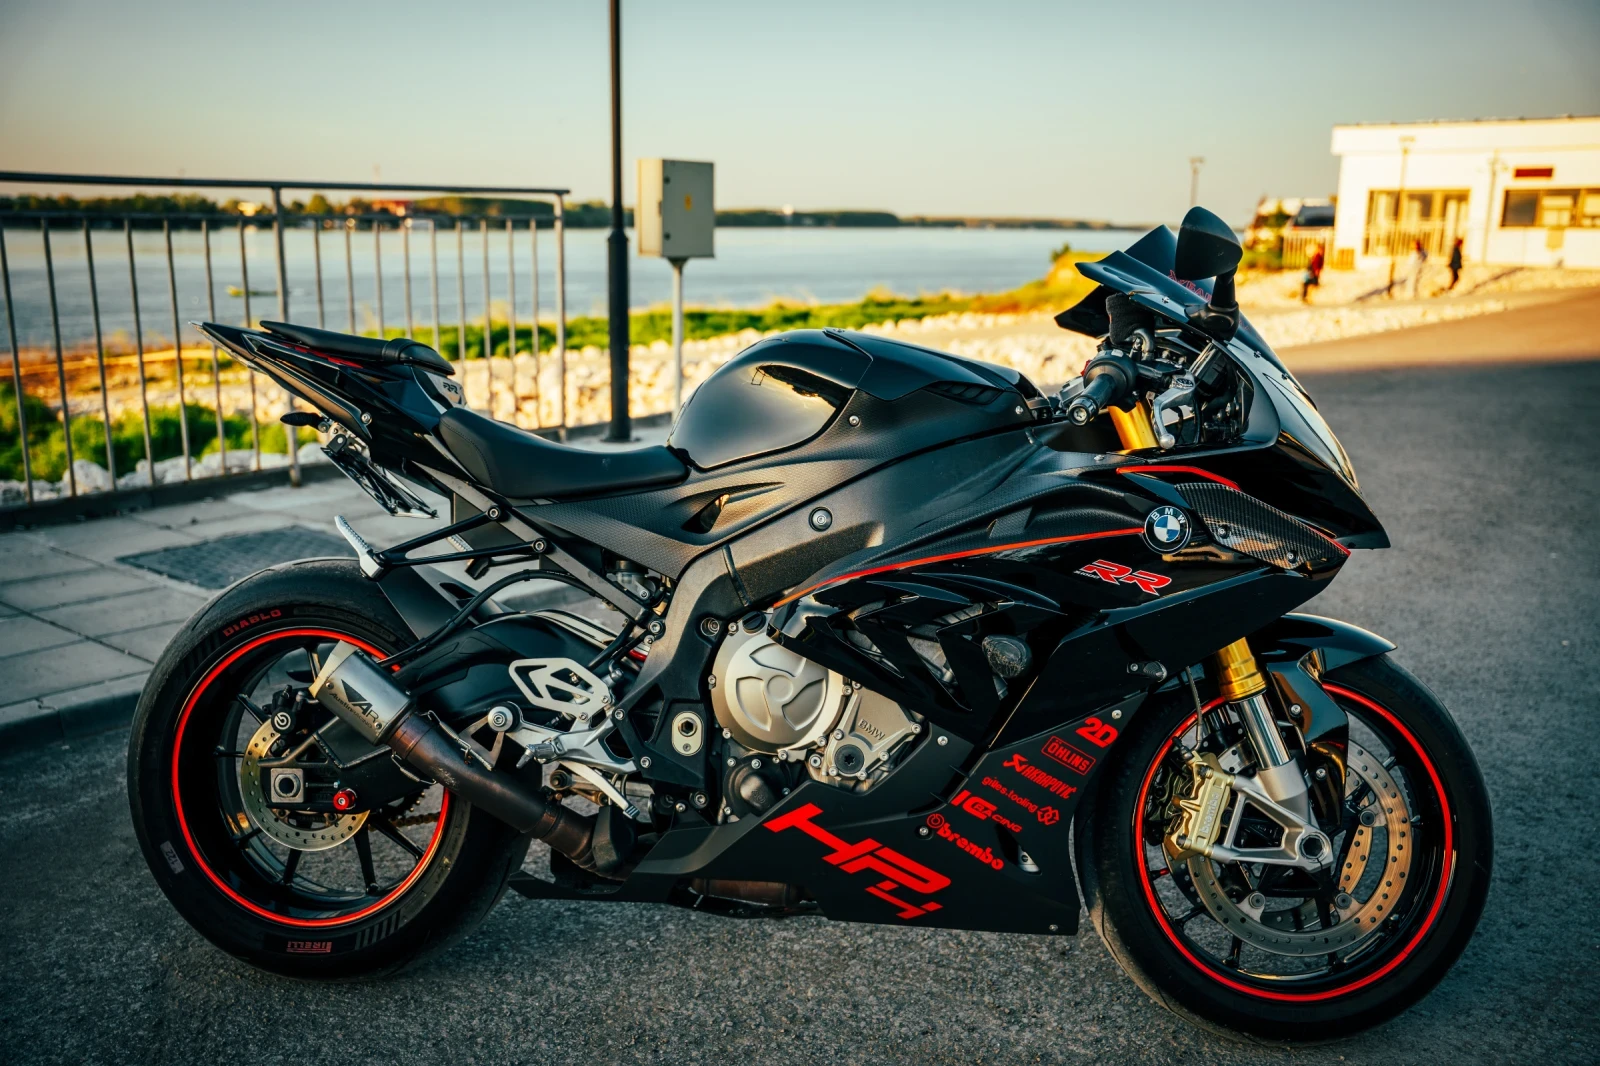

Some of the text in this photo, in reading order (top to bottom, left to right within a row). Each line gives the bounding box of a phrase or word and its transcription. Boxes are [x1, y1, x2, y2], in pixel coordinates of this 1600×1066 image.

[1080, 559, 1172, 597] RR
[222, 608, 282, 637] DIABLO
[858, 718, 886, 741] BMW
[1075, 716, 1119, 749] 2D
[1047, 739, 1090, 773] ÖHLINS
[981, 775, 1039, 814] gilles.tooling
[1200, 792, 1220, 834] brembo
[936, 822, 1005, 871] brembo
[286, 941, 332, 953] PIRELLI
